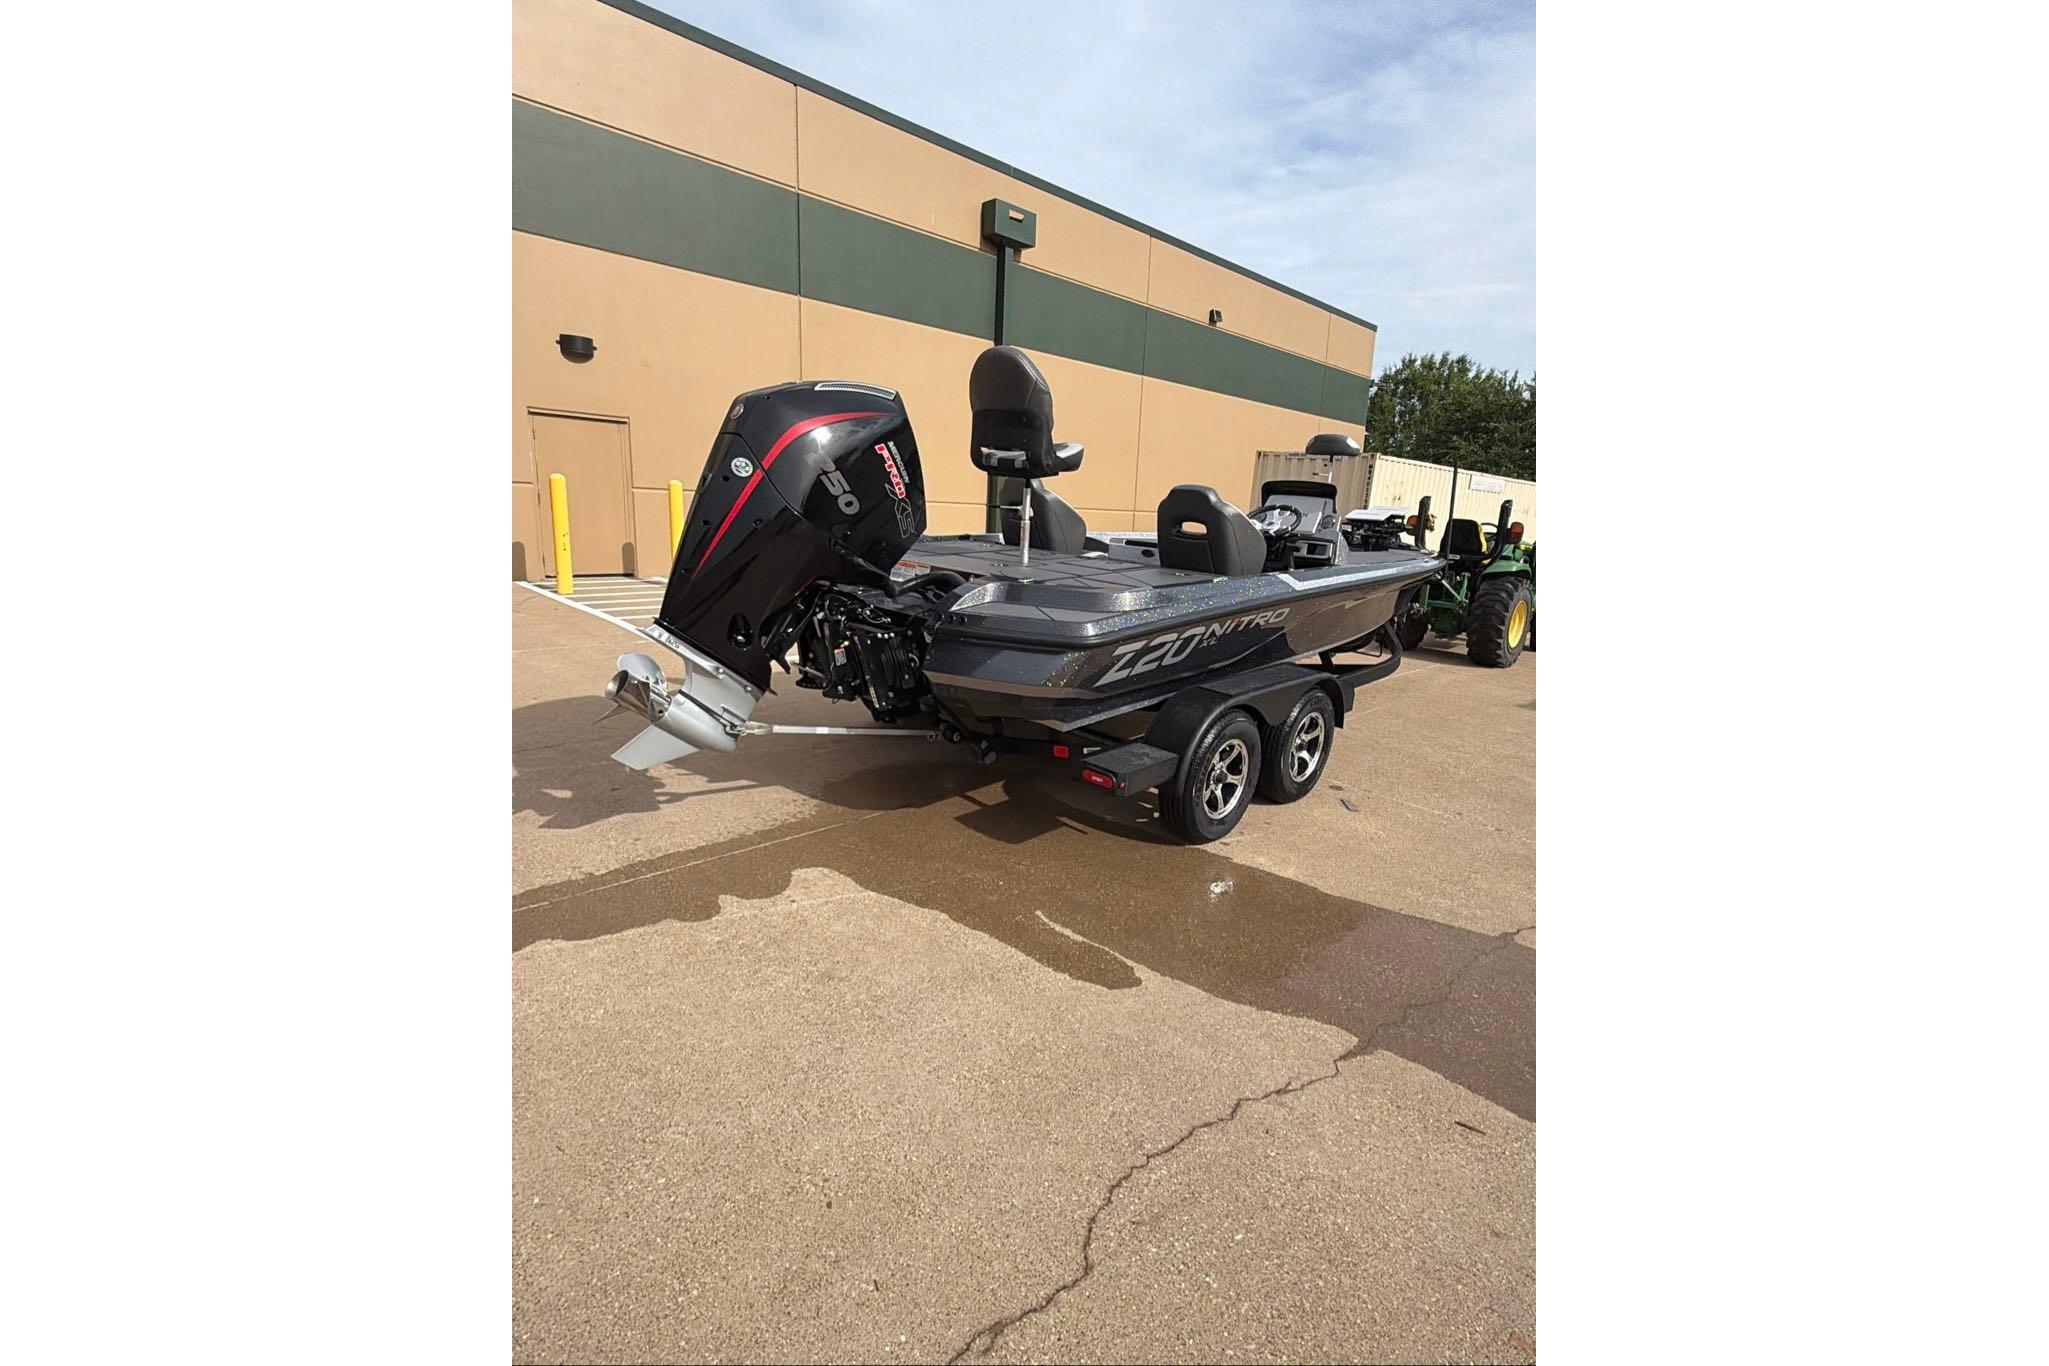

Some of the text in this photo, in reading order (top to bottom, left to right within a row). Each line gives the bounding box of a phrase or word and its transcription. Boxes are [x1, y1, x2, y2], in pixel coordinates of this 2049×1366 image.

[887, 441, 910, 484] MERCURY
[1092, 607, 1291, 688] Z20 NITRO
